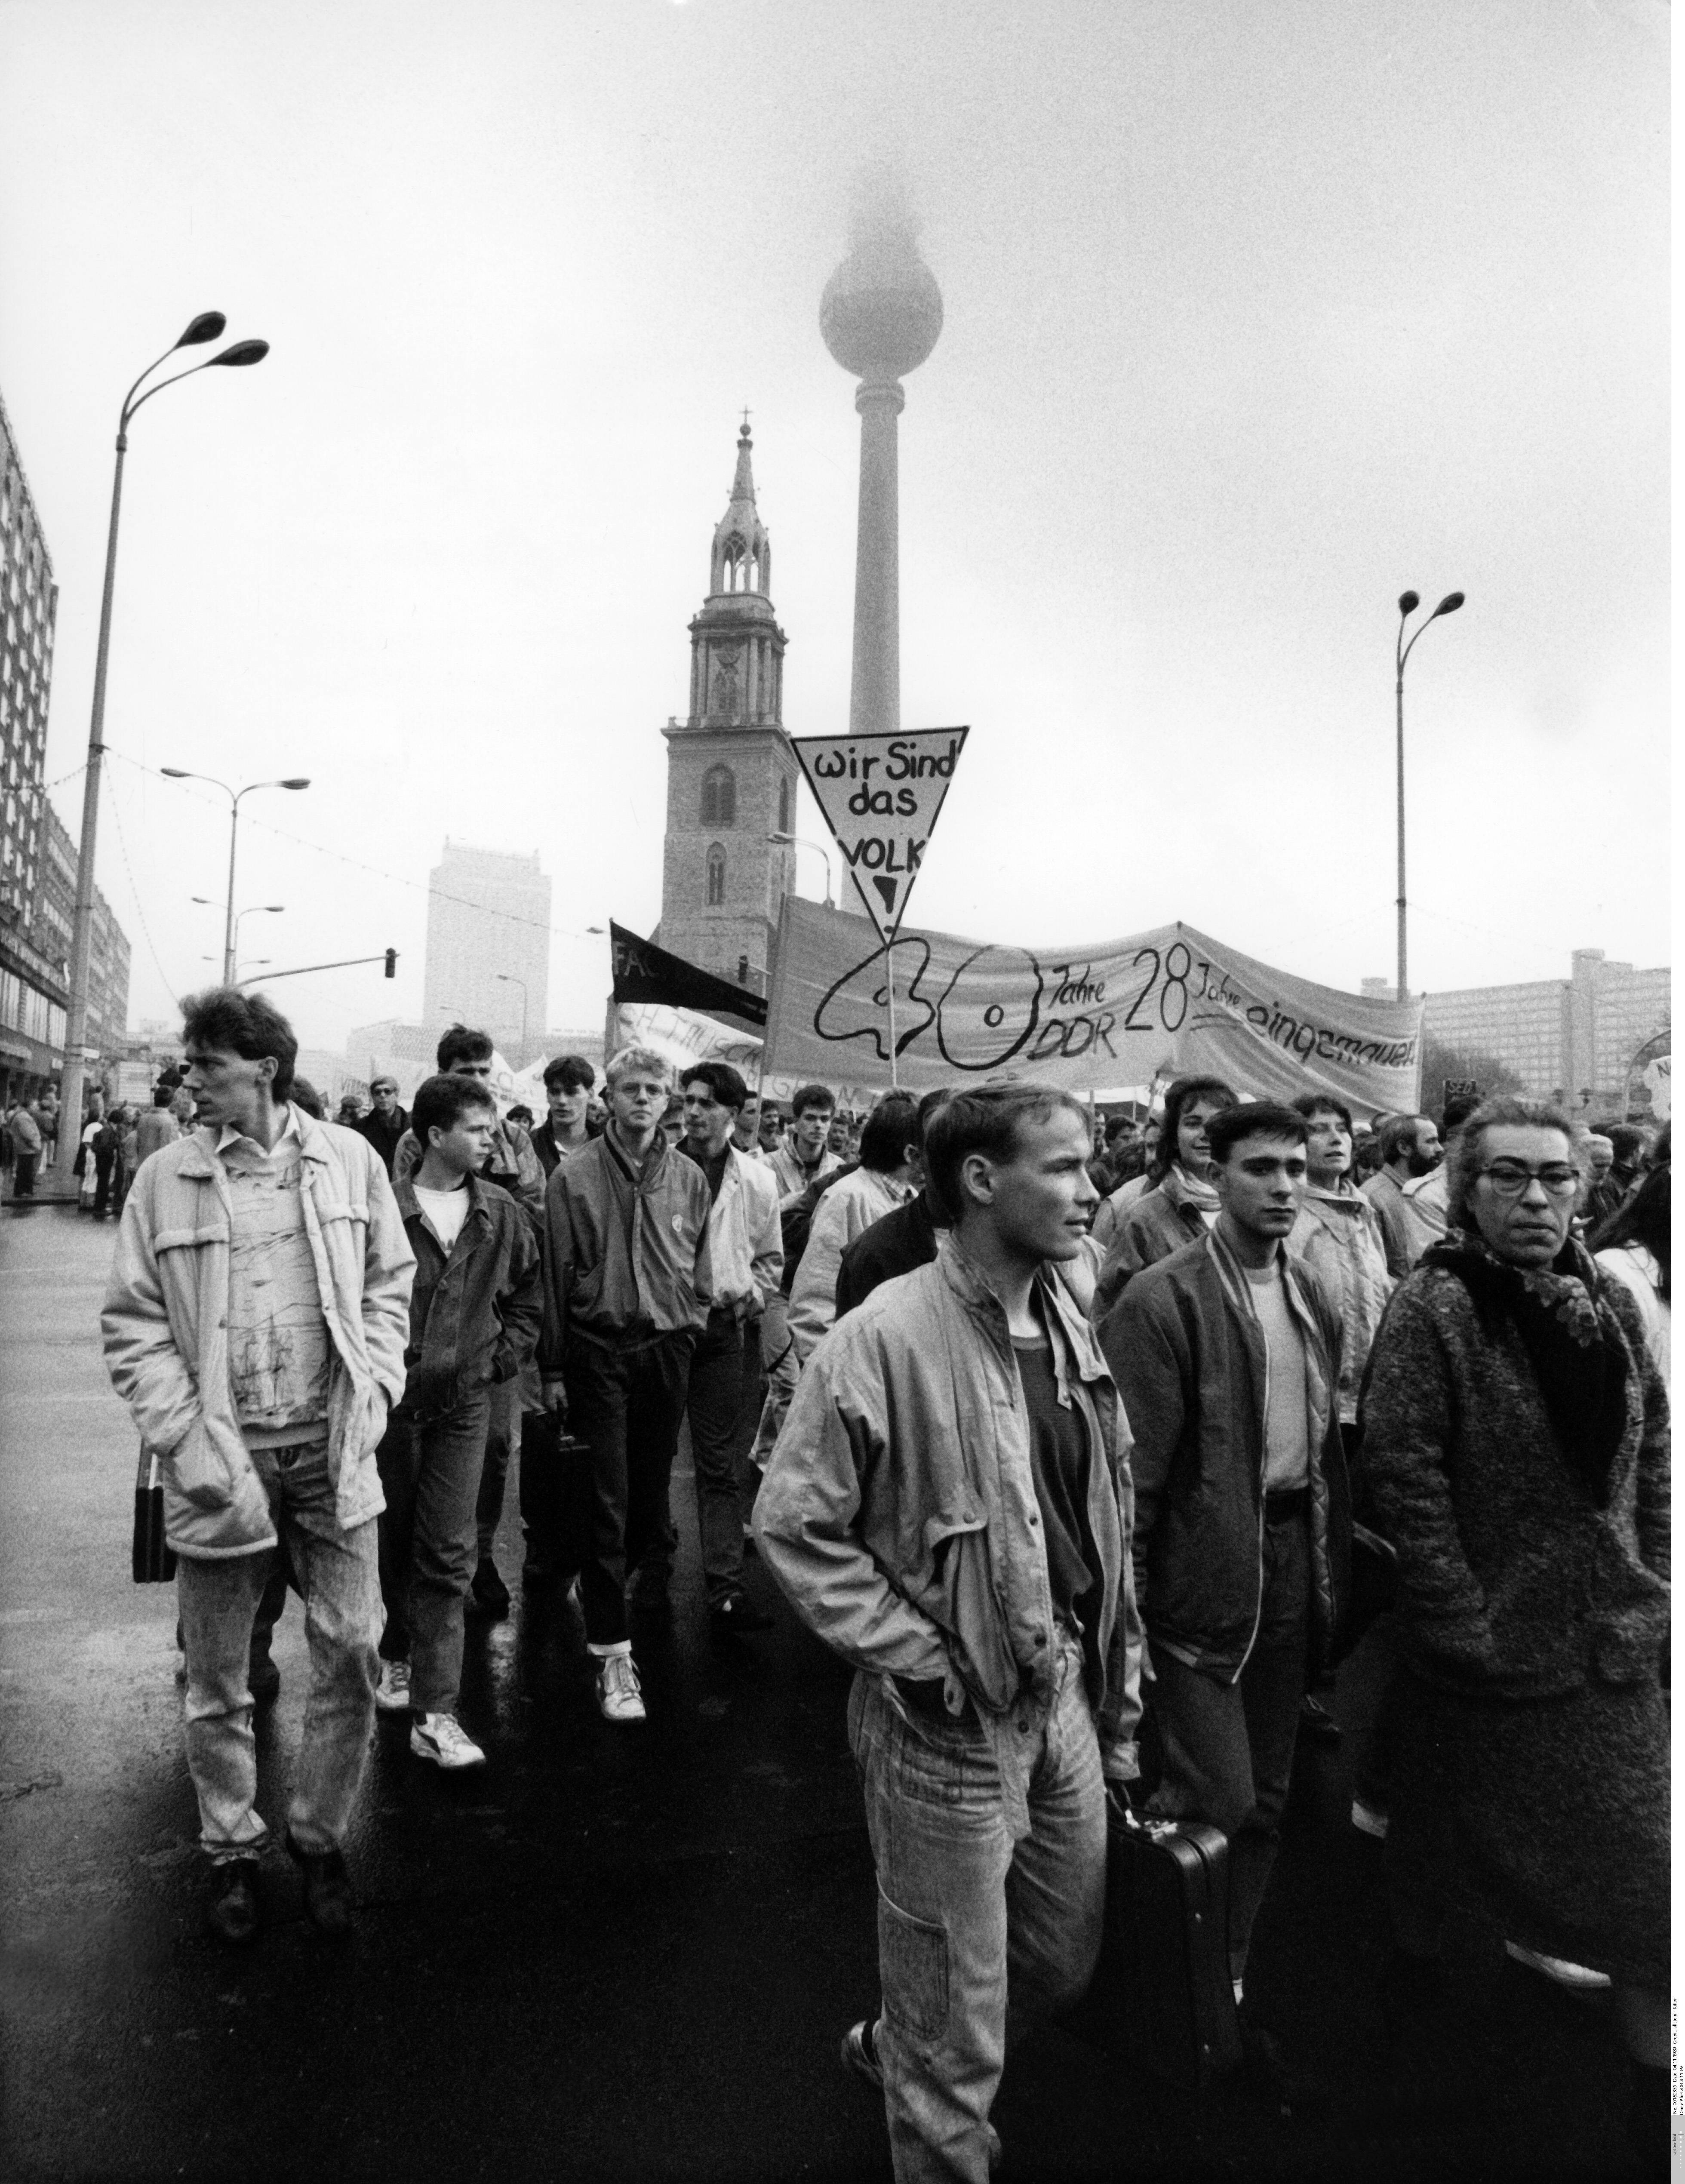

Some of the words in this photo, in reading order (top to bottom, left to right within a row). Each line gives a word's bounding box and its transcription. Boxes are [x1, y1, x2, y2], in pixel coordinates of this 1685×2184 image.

[886, 739, 957, 780] Sind
[848, 782, 918, 816] das
[837, 838, 926, 873] VOLK
[1048, 964, 1106, 1009] Jahre
[1125, 943, 1191, 1032] 28
[1027, 1012, 1117, 1061] DDR
